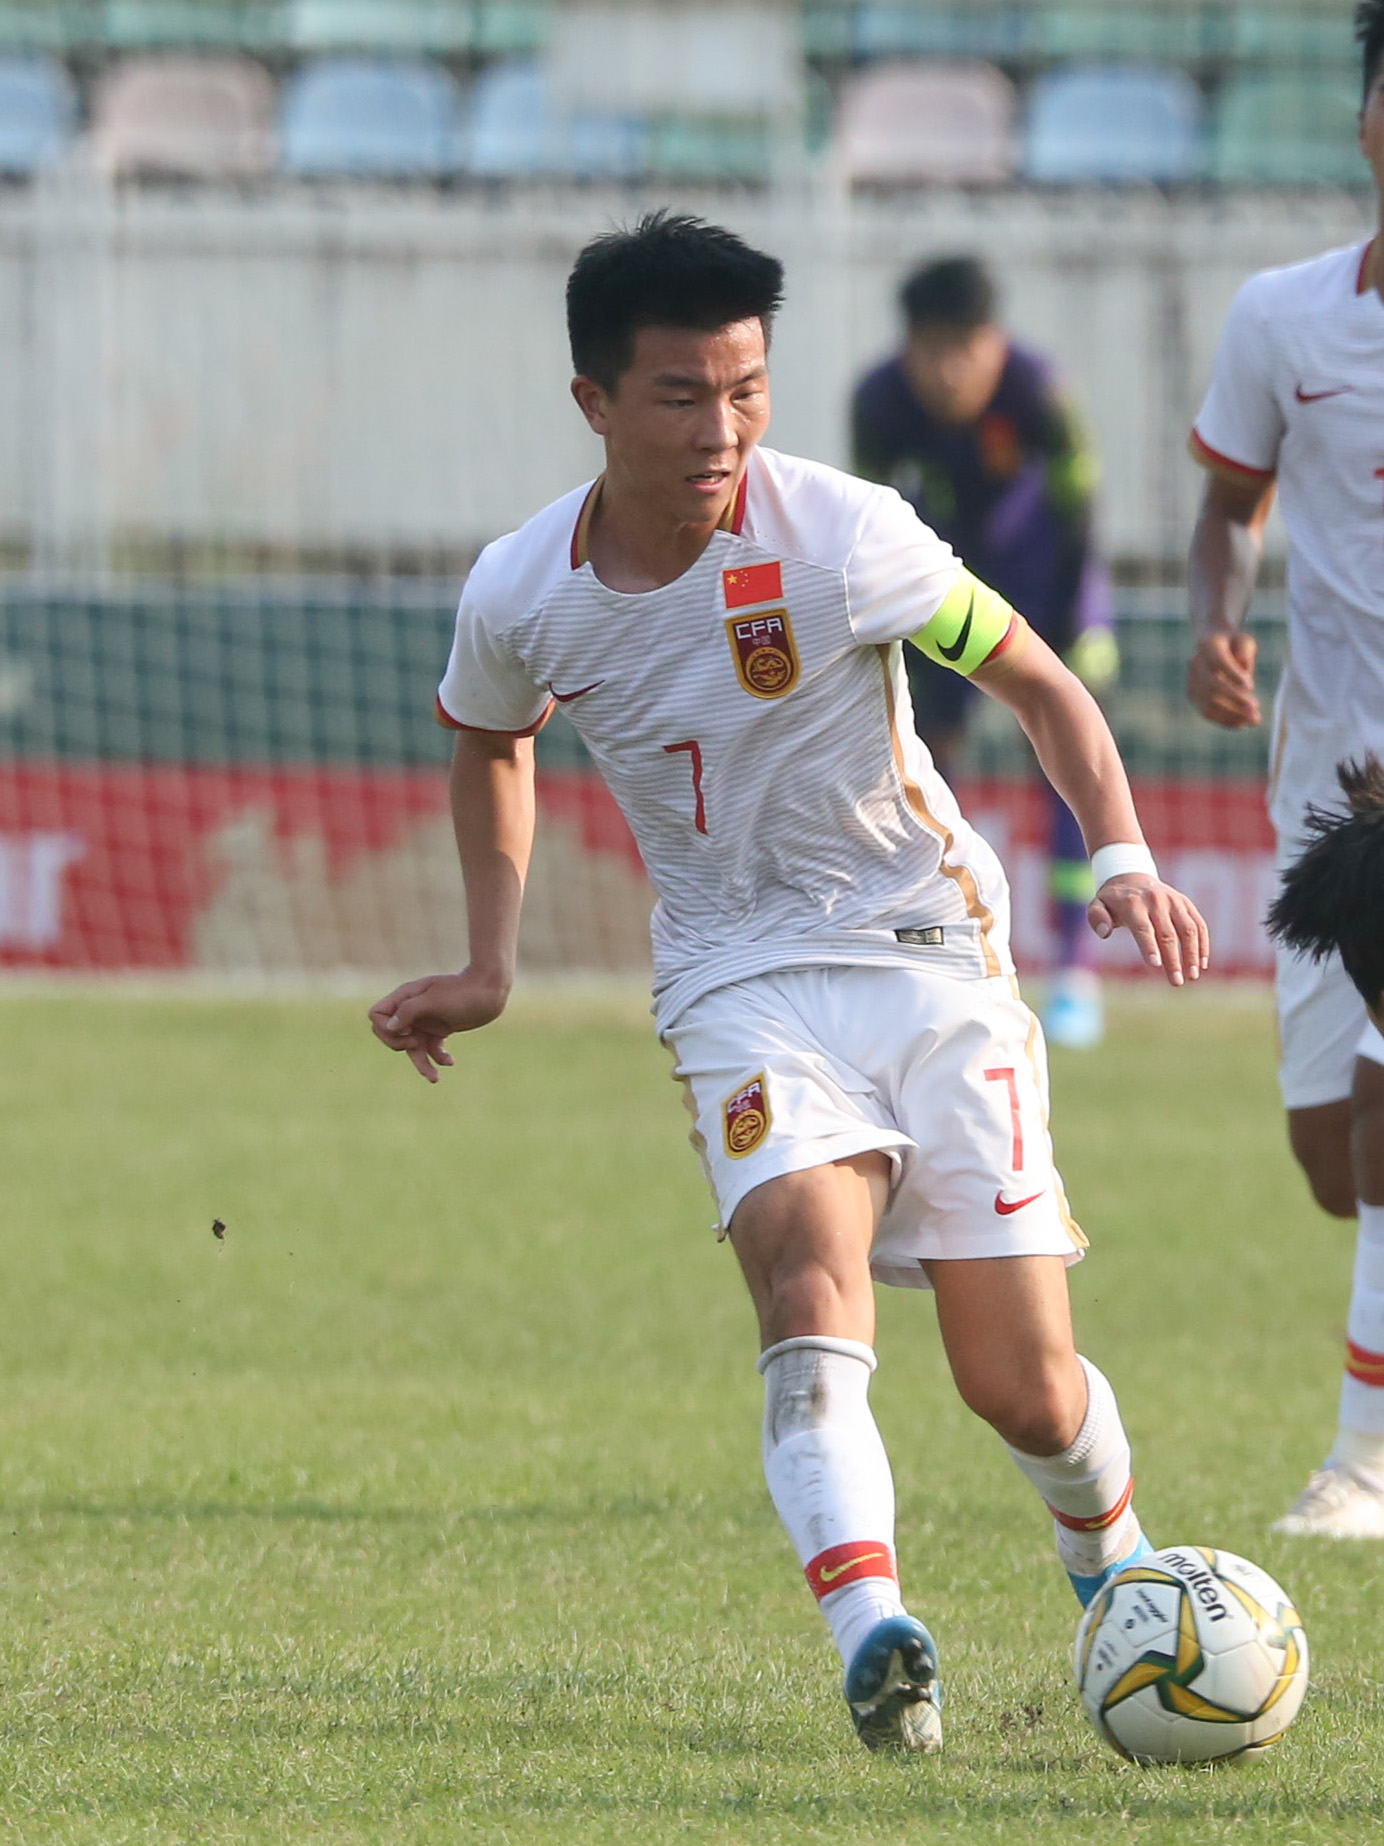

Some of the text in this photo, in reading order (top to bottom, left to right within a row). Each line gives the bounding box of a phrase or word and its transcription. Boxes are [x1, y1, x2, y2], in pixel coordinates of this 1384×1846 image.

[734, 617, 783, 640] CFA
[661, 740, 709, 835] 7
[983, 1067, 1024, 1171] 7
[1158, 1552, 1228, 1622] molten
